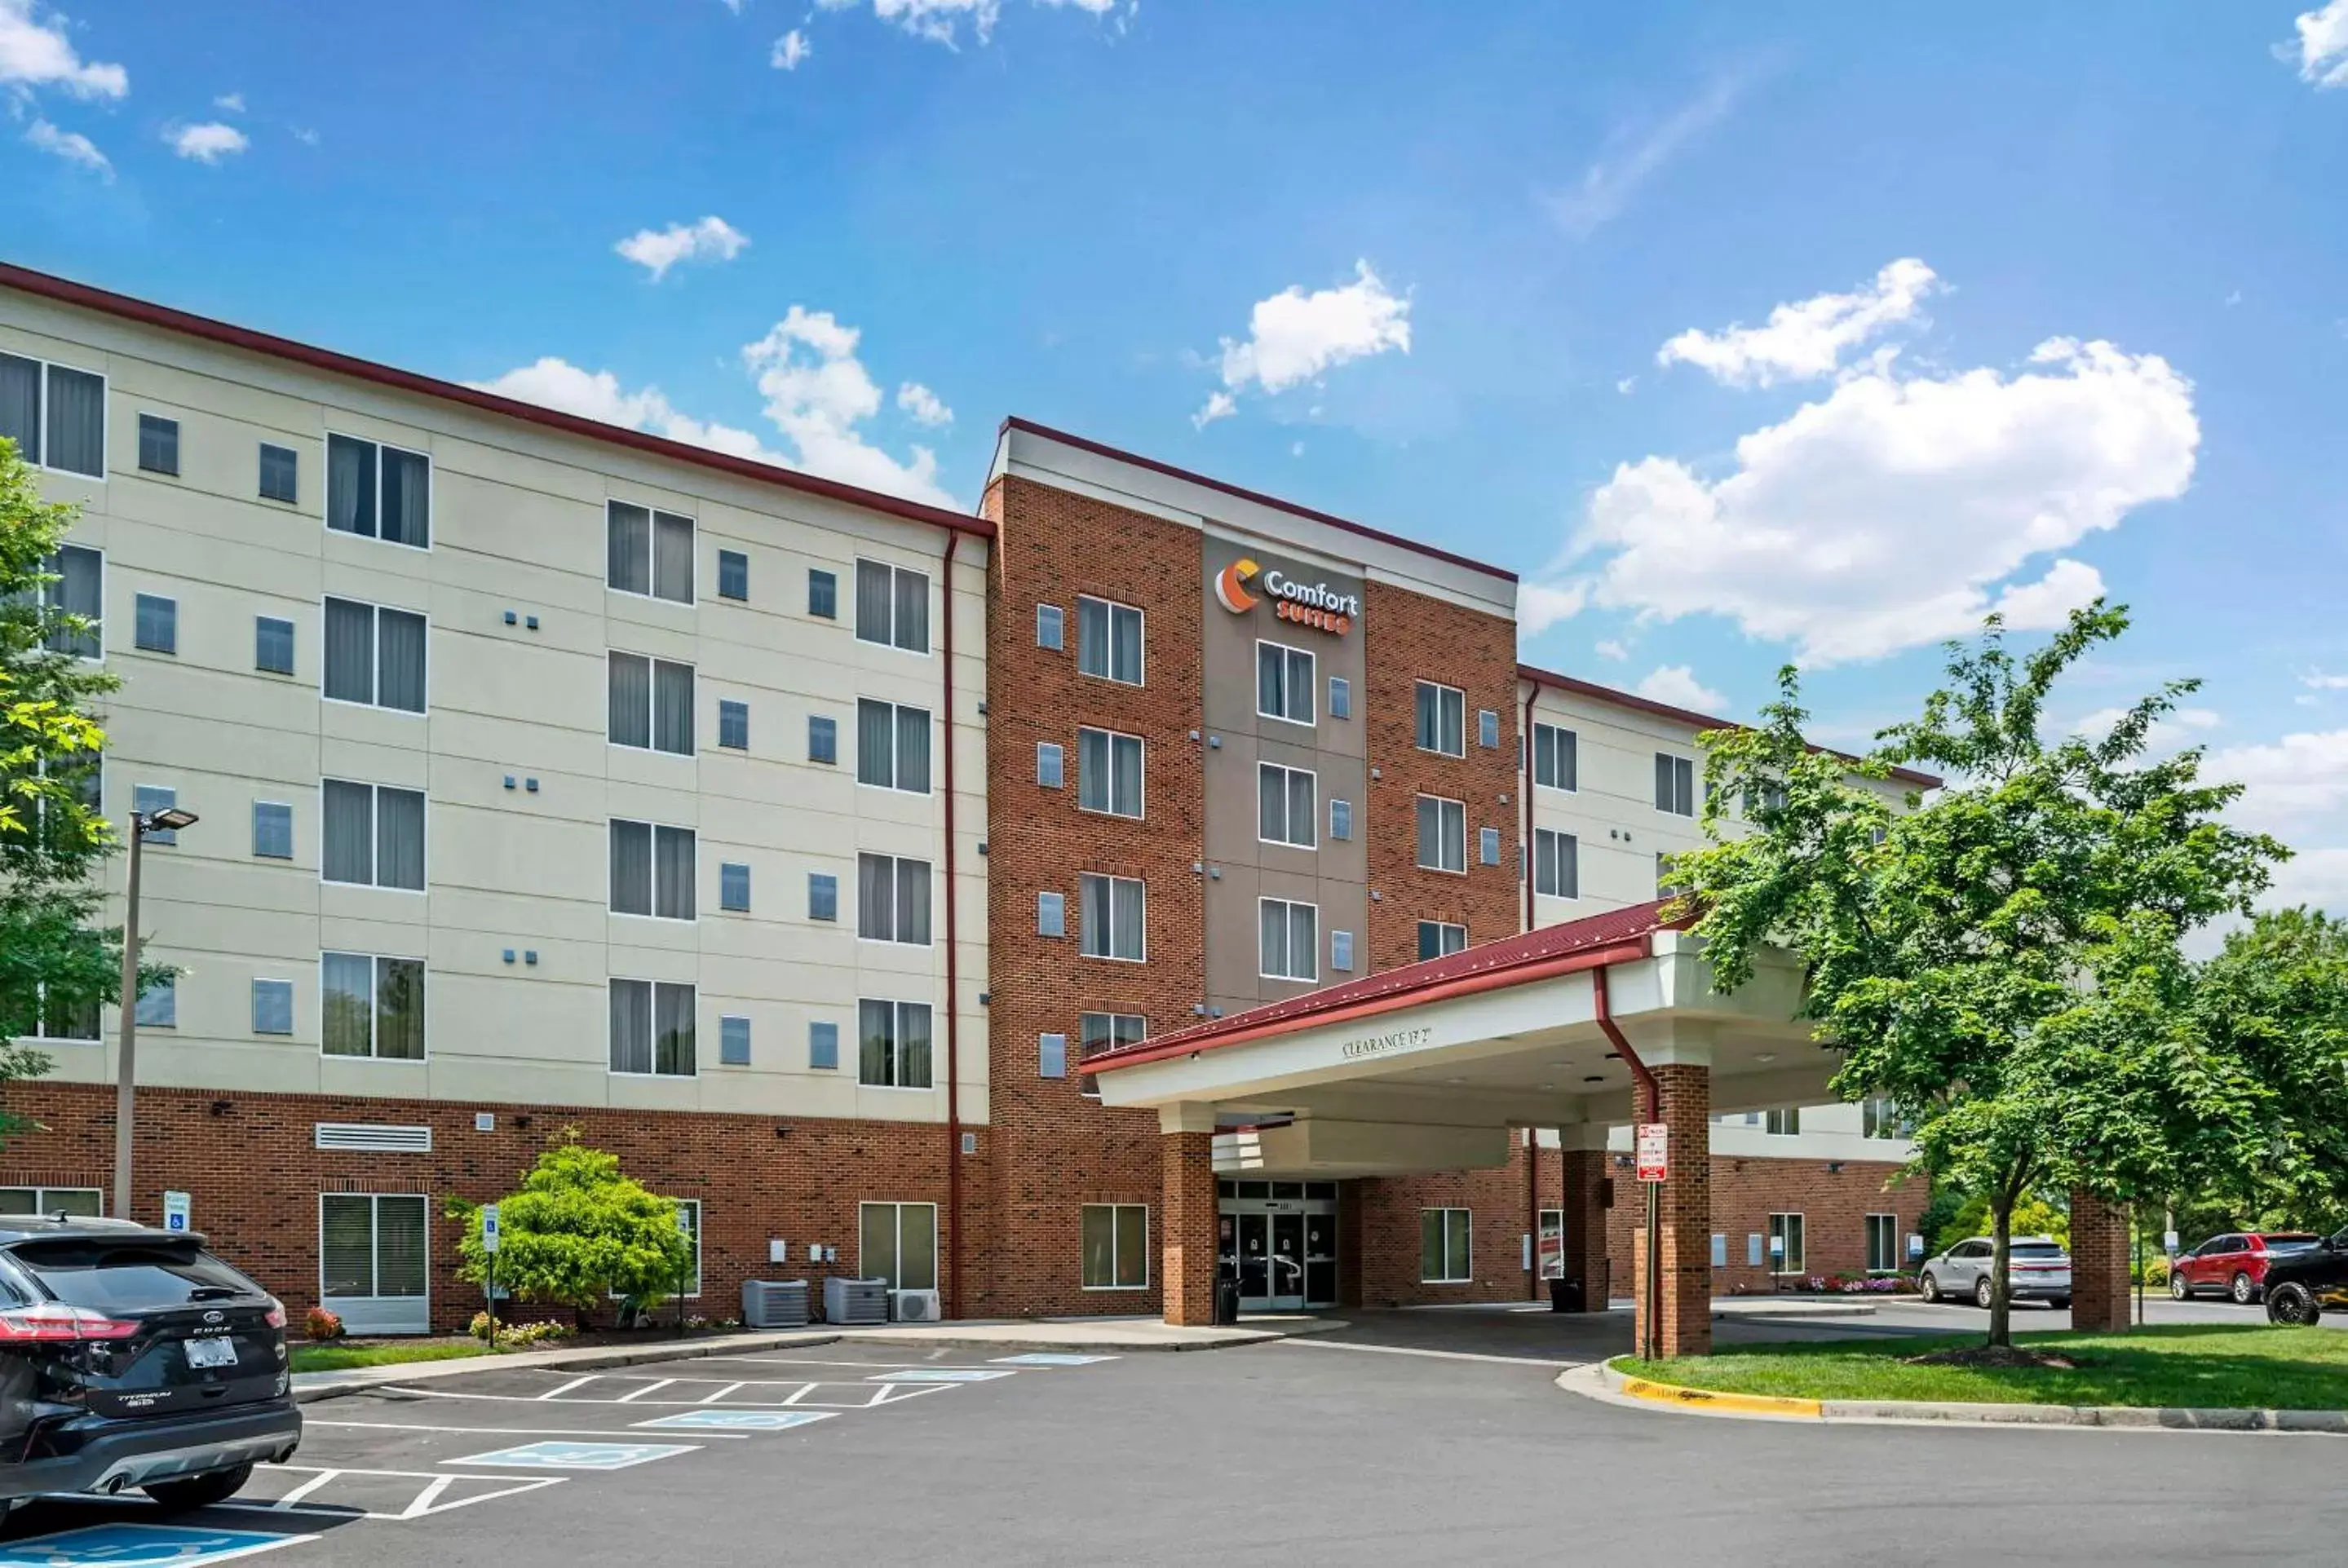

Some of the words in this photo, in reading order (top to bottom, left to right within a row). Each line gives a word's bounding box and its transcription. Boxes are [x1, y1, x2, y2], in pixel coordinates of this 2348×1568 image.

[1265, 571, 1358, 616] Comfort
[1276, 600, 1351, 635] SUITES
[1342, 1032, 1407, 1058] CLEARANCE
